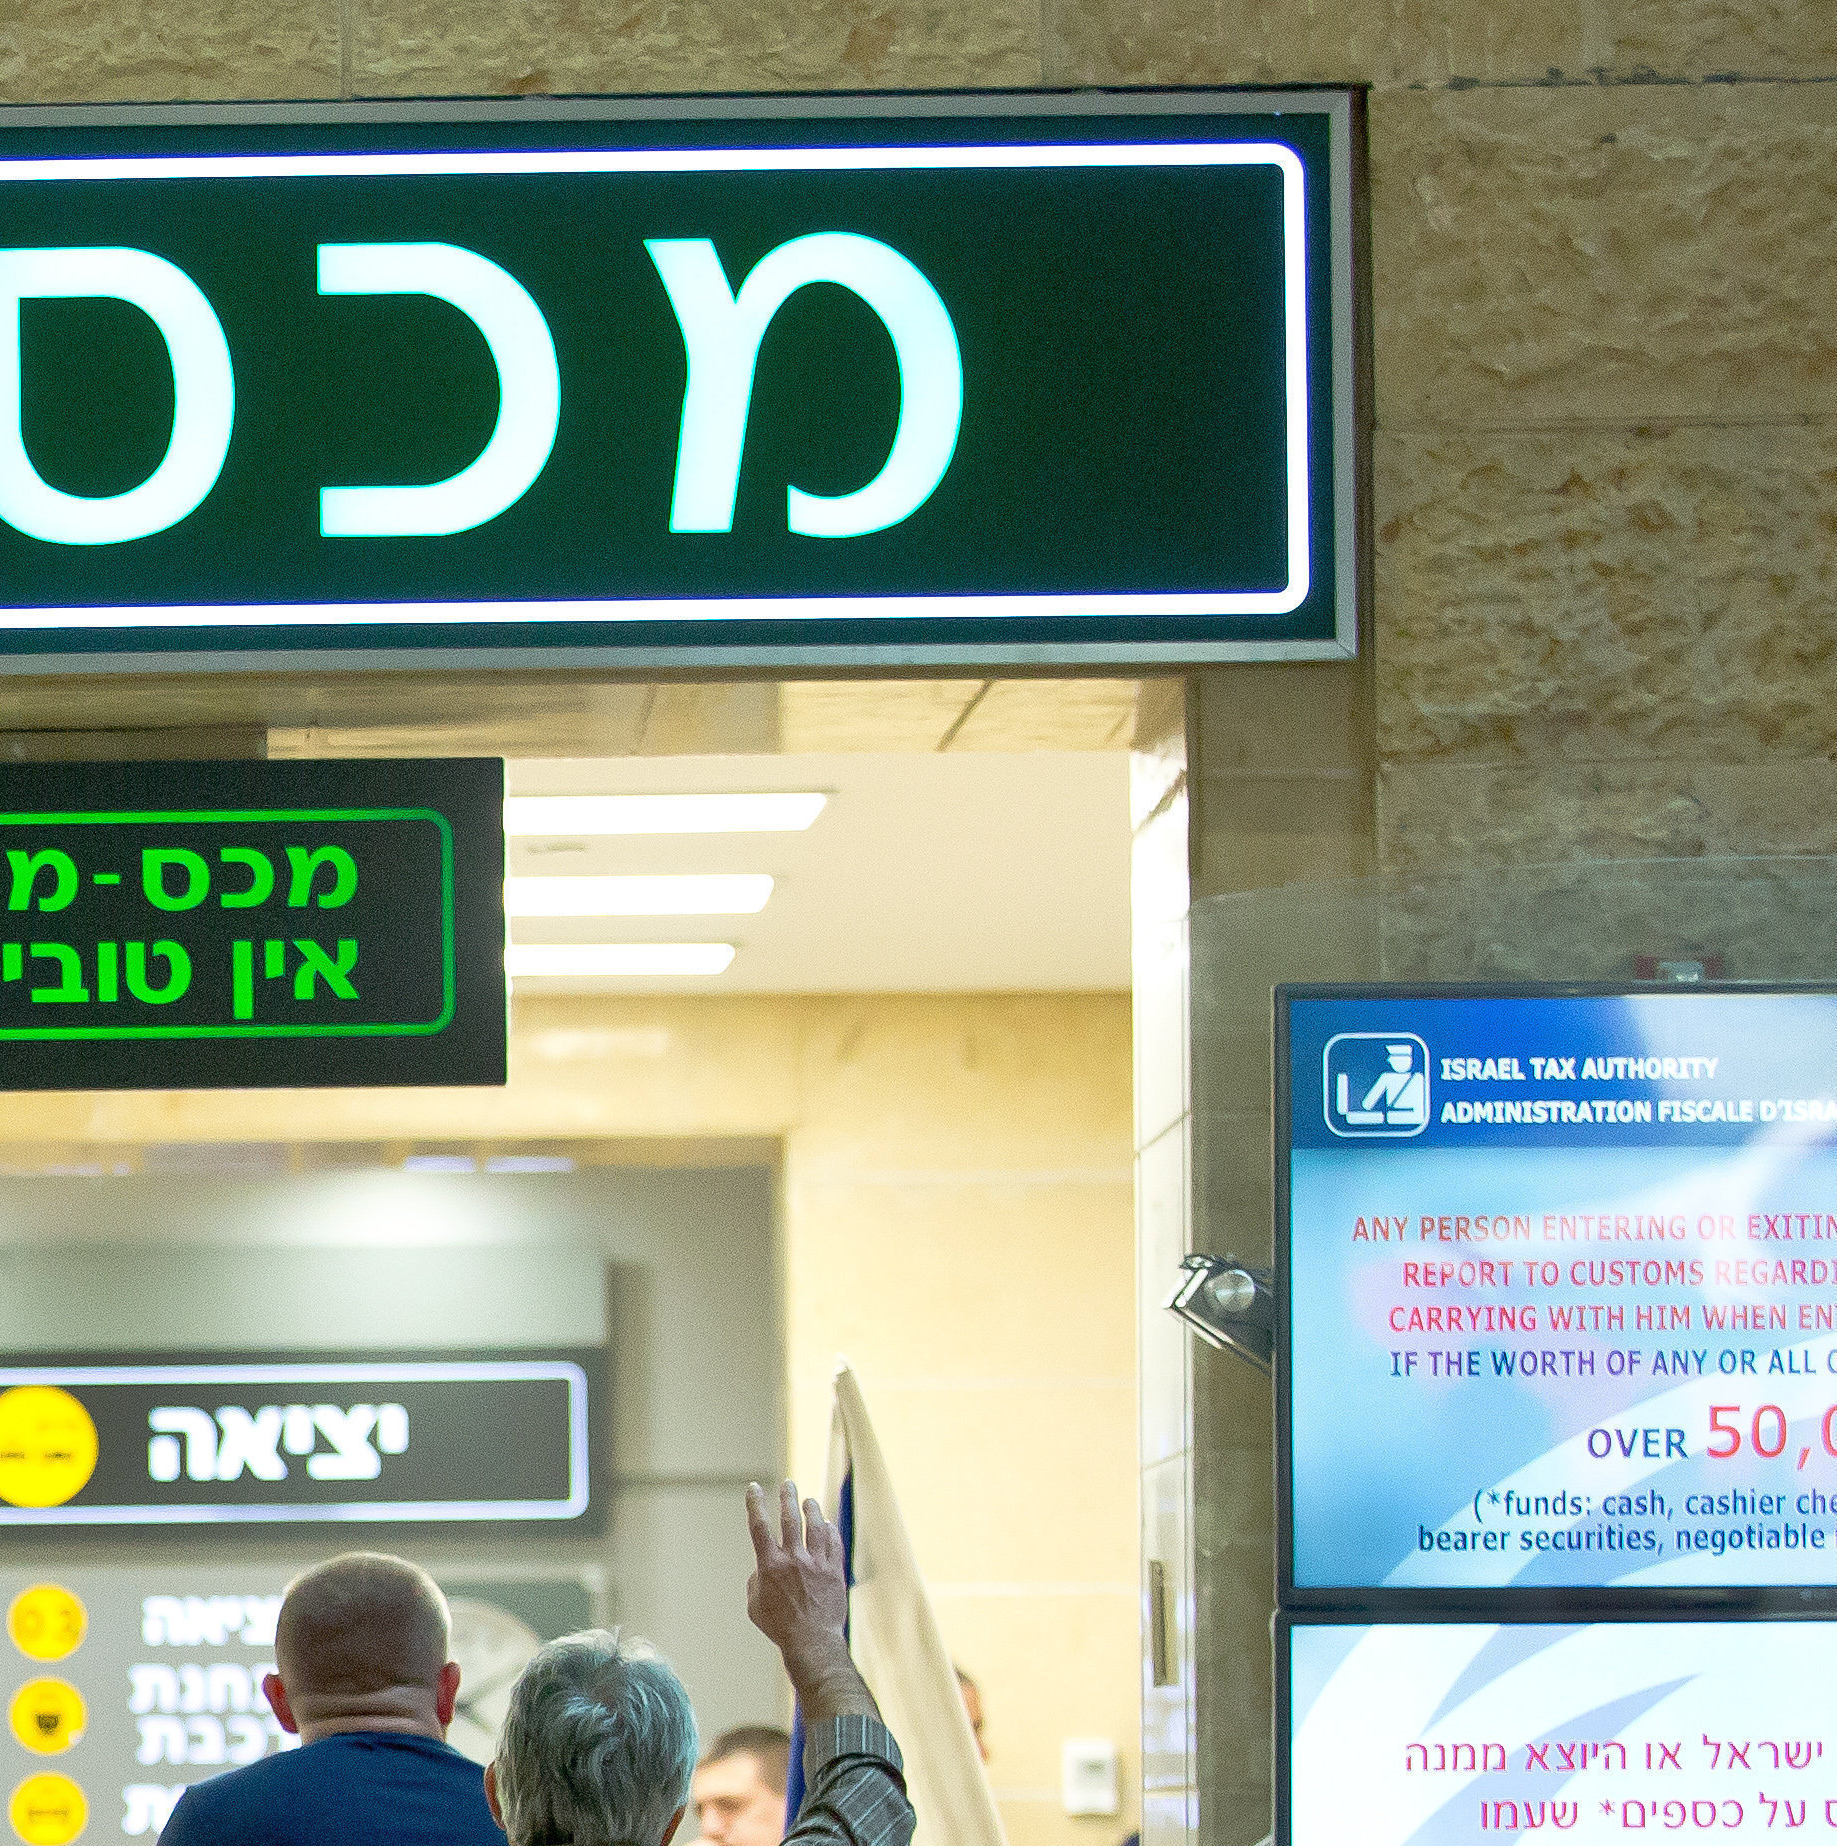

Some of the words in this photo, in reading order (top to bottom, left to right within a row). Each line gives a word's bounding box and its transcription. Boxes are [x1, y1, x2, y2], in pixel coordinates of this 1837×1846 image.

[229, 932, 362, 1020] אין
[1439, 1056, 1526, 1081] ISRAEL
[1529, 1056, 1577, 1080] TAX
[1580, 1055, 1720, 1080] AUTHORITY
[1440, 1100, 1652, 1125] ADMINISTRATION
[1657, 1099, 1753, 1124] FISCALE
[1352, 1217, 1408, 1242] ANY
[1421, 1216, 1532, 1242] PERSON
[1542, 1216, 1687, 1242] ENTERING
[1696, 1216, 1737, 1242] OR
[1402, 1262, 1512, 1287] REPORT
[1526, 1262, 1560, 1286] TO
[1570, 1261, 1704, 1286] CUSTOMS
[1388, 1306, 1537, 1332] CARRYING
[1548, 1306, 1625, 1331] WITH
[1635, 1305, 1691, 1331] HIM
[1701, 1304, 1789, 1331] WHEN
[1798, 1304, 1837, 1331] EN
[1390, 1351, 1419, 1377] IF
[1430, 1351, 1481, 1377] THE
[1492, 1351, 1596, 1377] WORTH
[1606, 1350, 1642, 1377] OF
[1651, 1350, 1707, 1376] ANY
[1718, 1350, 1758, 1376] OR
[1768, 1350, 1817, 1375] ALL
[147, 1401, 411, 1484] יציאה
[1587, 1428, 1688, 1459] OVER
[1602, 1491, 1674, 1521] cash,
[1685, 1491, 1787, 1516] cashier
[1417, 1525, 1509, 1551] bearer
[1520, 1525, 1663, 1554] securities,
[1675, 1524, 1824, 1556] negotiable
[141, 1594, 284, 1646] ציאה
[1405, 1740, 1506, 1772] ממנה
[1524, 1741, 1627, 1772] היוצא
[1644, 1741, 1682, 1771] או
[1701, 1733, 1823, 1771] ישראל
[1479, 1799, 1578, 1831] שעמו
[1758, 1792, 1807, 1830] על
